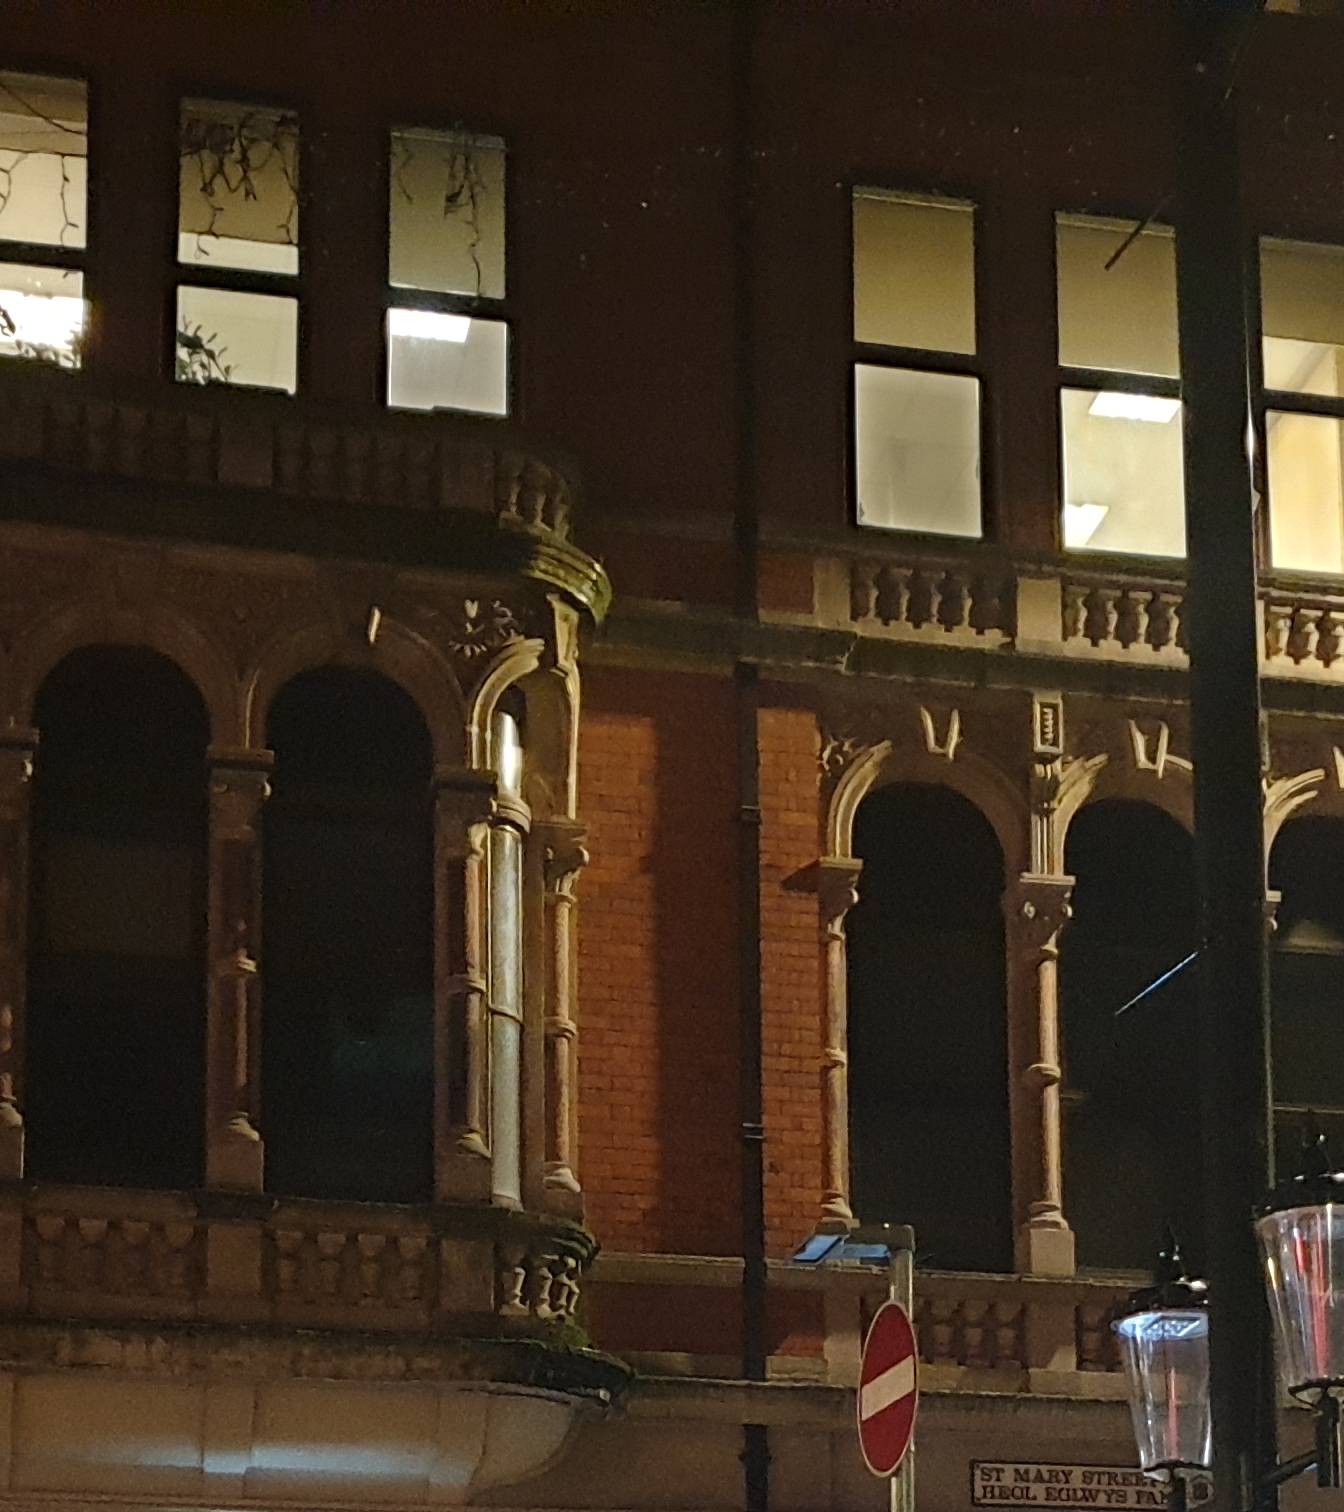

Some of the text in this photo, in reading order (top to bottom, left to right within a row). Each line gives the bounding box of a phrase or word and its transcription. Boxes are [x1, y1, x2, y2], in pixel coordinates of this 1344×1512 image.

[980, 1467, 1005, 1482] ST
[1013, 1468, 1073, 1484] MARY
[981, 1485, 1037, 1501] HEOL
